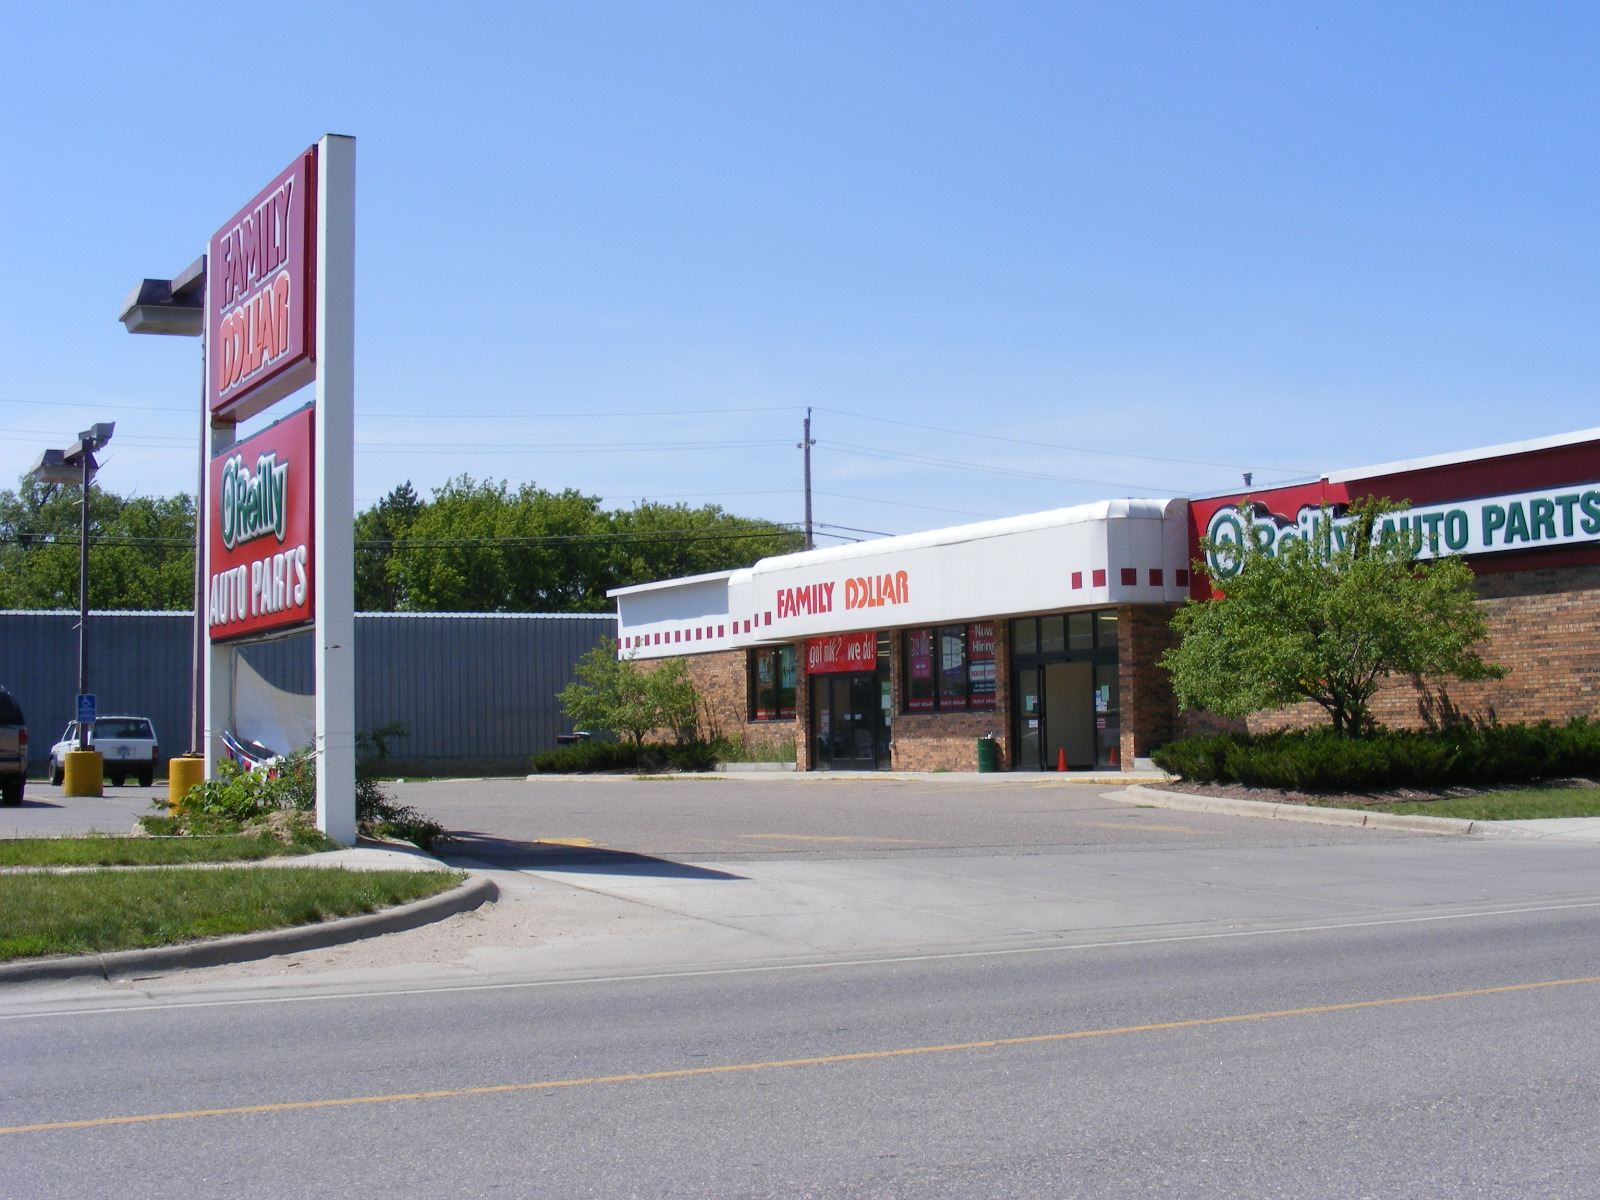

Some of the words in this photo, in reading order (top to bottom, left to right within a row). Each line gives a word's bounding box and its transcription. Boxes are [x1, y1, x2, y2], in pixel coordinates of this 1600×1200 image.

[219, 174, 295, 314] FAMILY
[219, 270, 290, 397] DOLLAR
[220, 453, 288, 550] O'Reilly
[1380, 509, 1468, 557] AUTO
[1482, 490, 1600, 546] PARTS
[209, 564, 247, 627] AUTO
[251, 544, 307, 617] PARTS
[777, 582, 835, 619] FAMILY
[845, 570, 909, 611] DOLLAR
[810, 640, 822, 668] got
[847, 642, 860, 660] we
[972, 640, 995, 655] Hiring
[974, 624, 993, 637] Now
